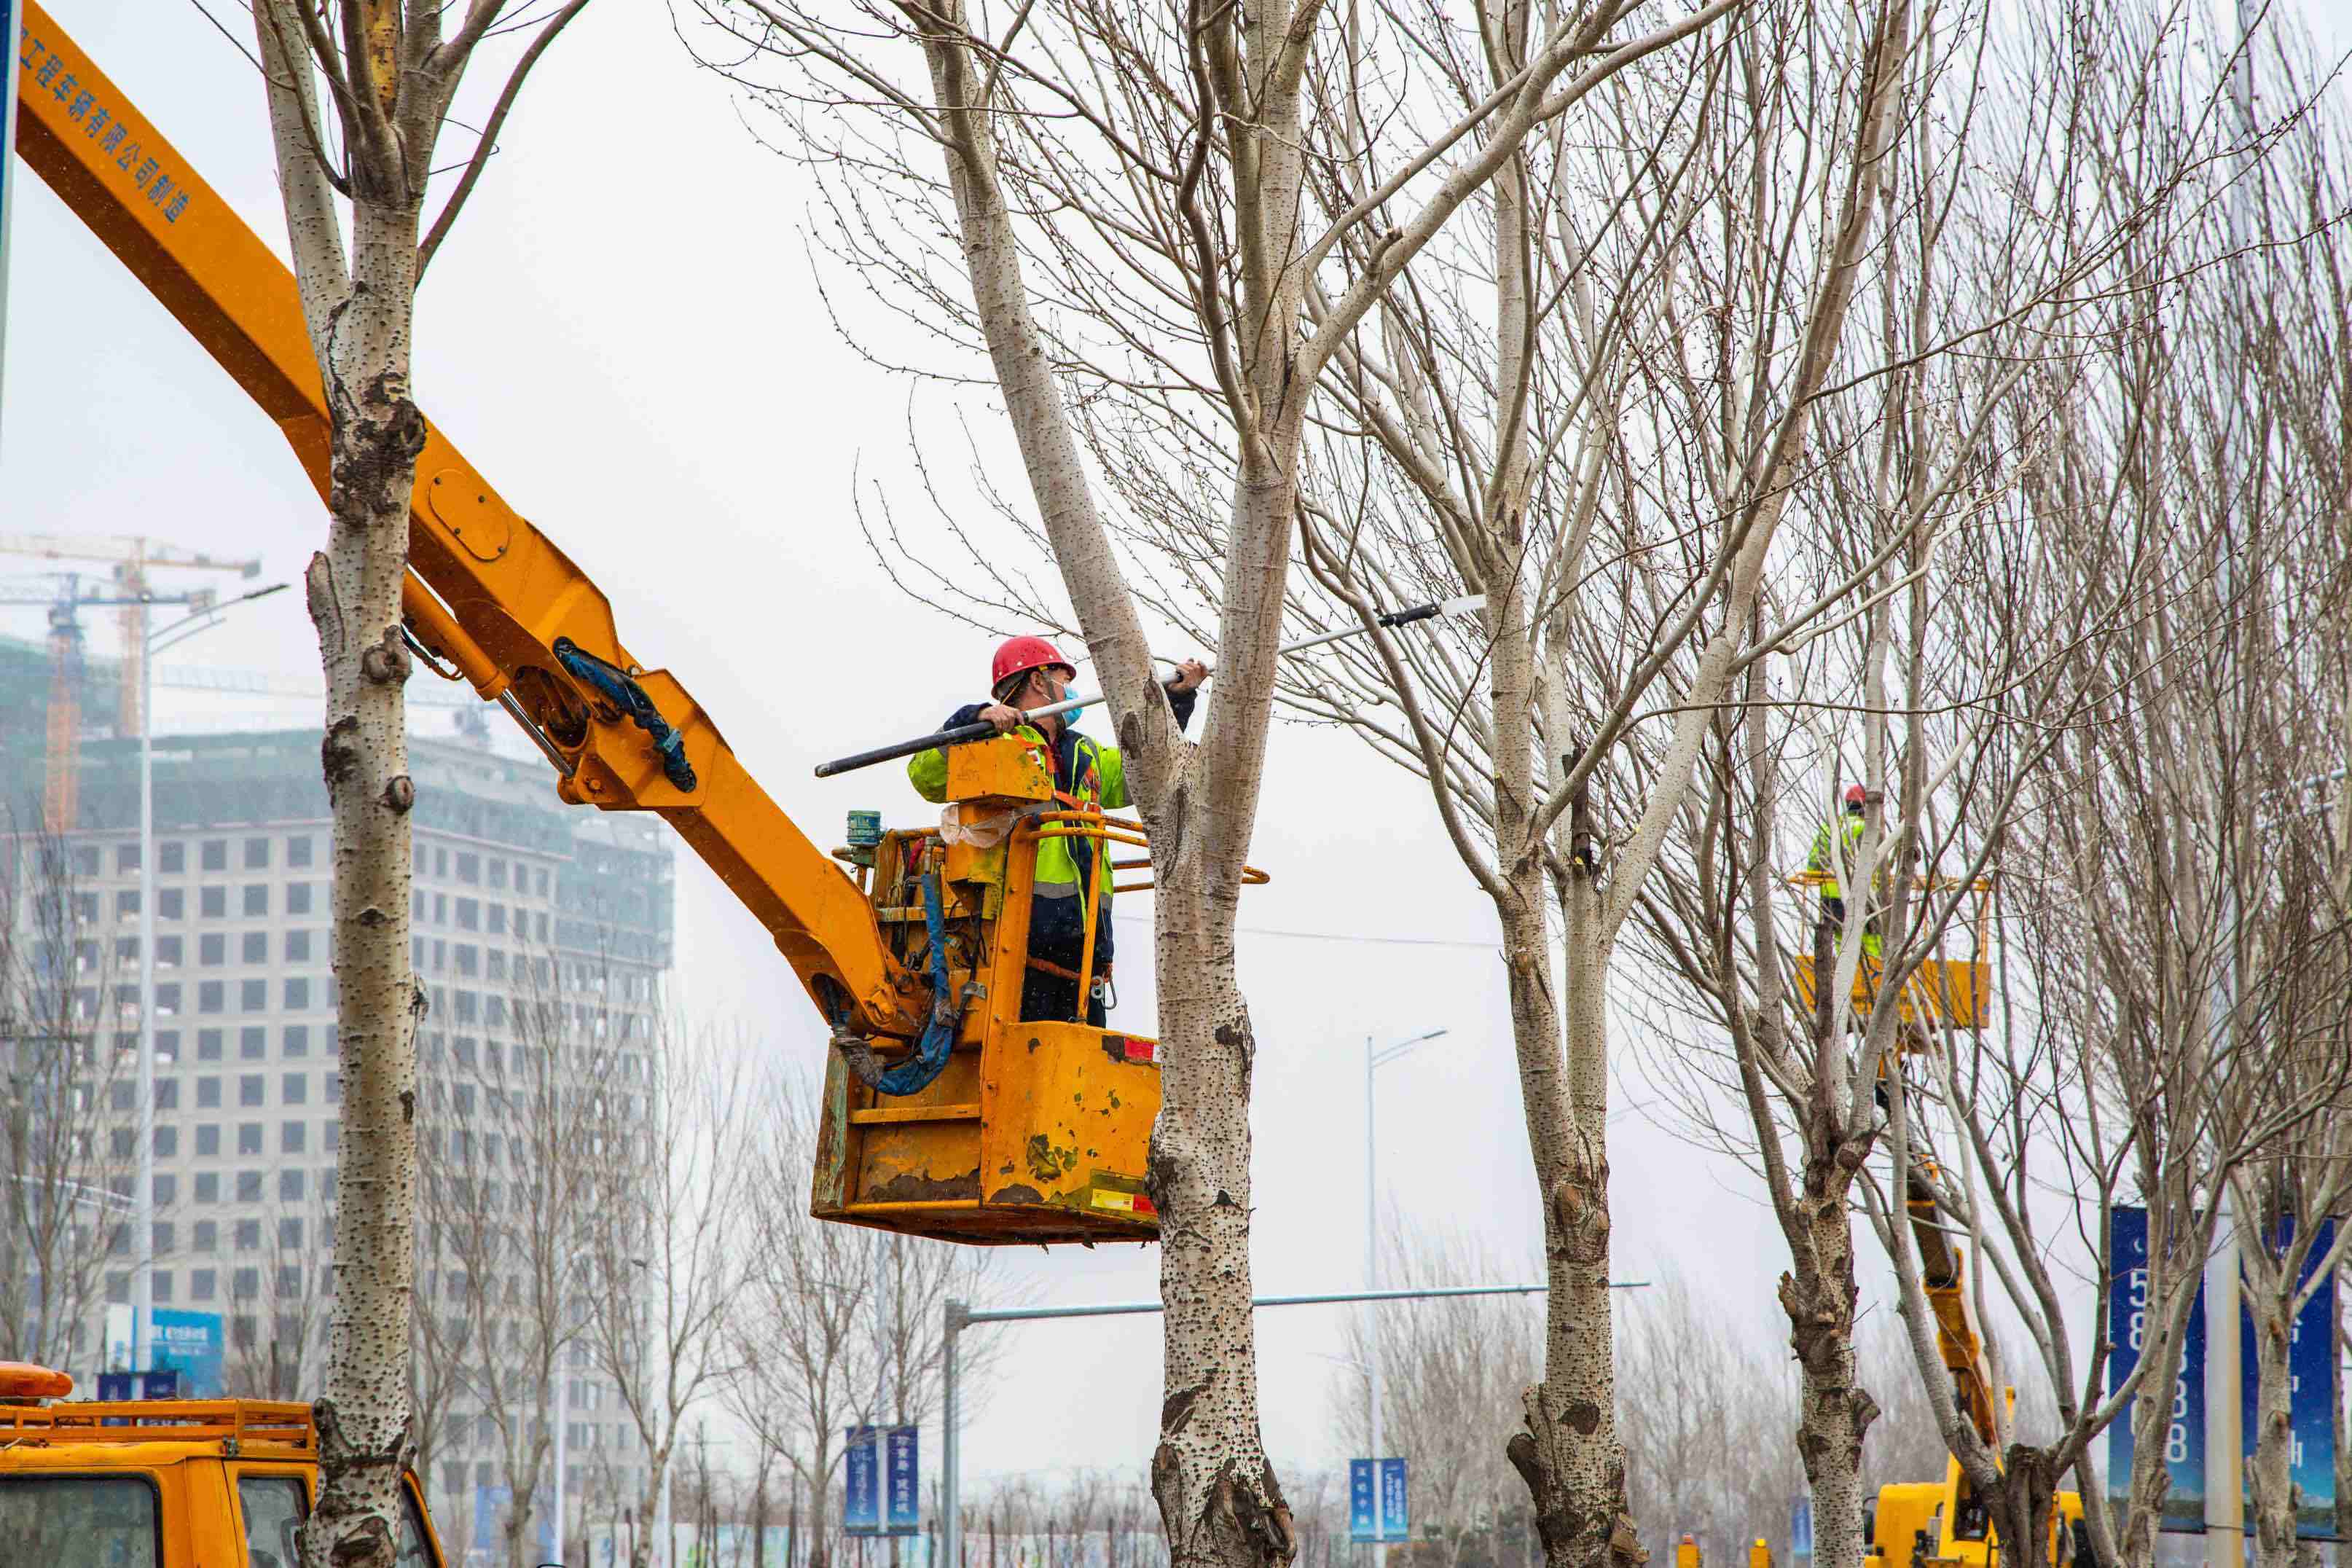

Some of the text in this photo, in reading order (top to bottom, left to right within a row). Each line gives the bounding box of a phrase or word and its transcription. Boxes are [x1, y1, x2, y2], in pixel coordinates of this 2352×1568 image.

[20, 28, 189, 223] 工程车辆有限公司制造
